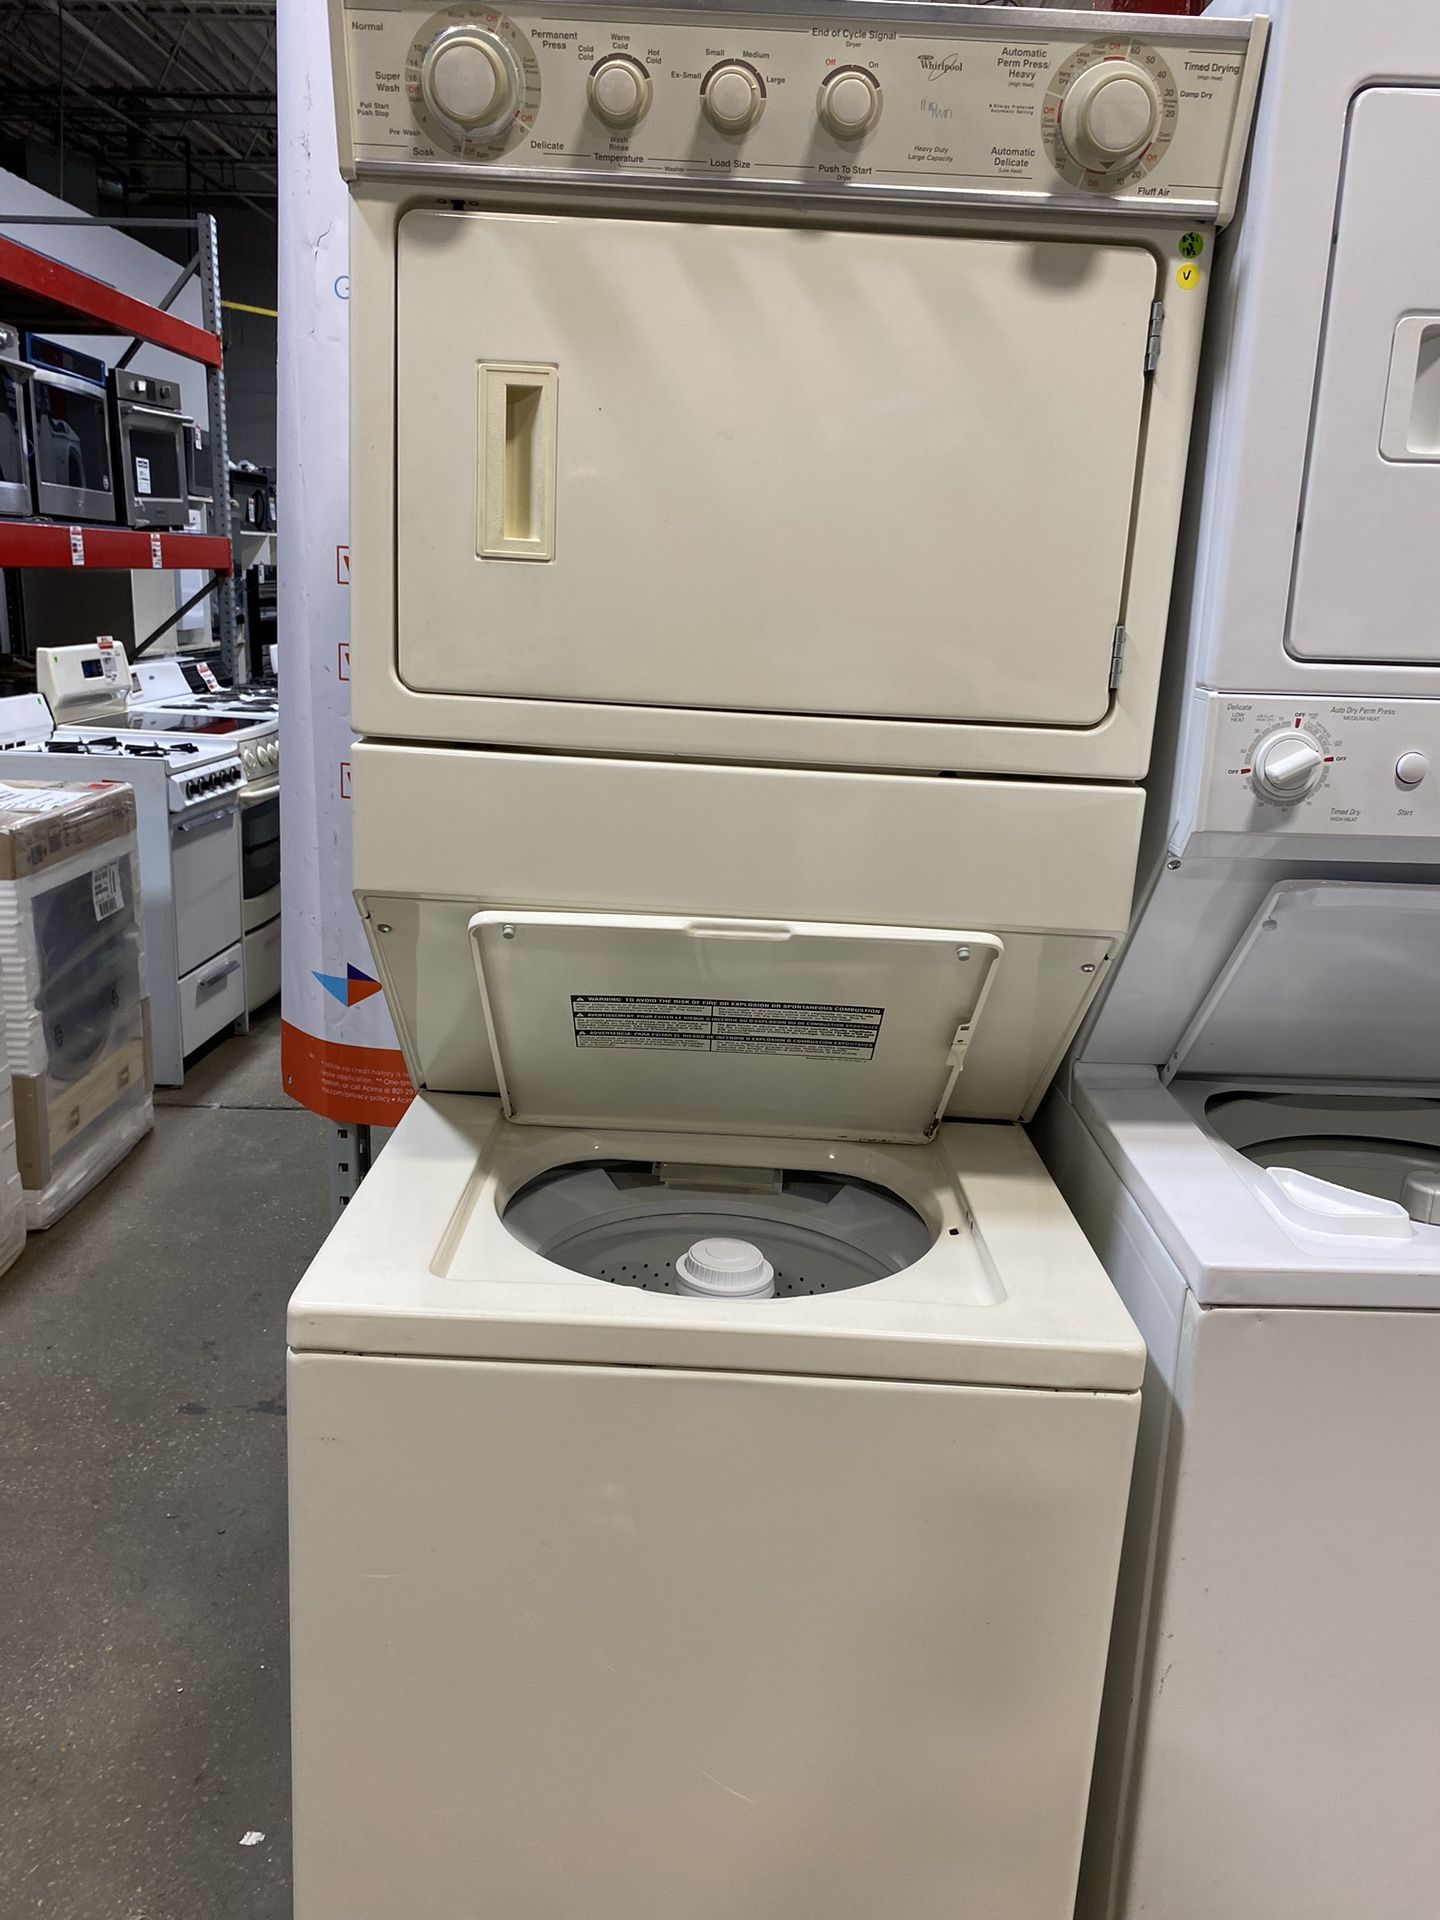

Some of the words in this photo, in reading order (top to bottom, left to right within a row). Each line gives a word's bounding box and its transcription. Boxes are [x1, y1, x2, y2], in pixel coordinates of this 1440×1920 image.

[351, 21, 384, 31] Normal
[531, 30, 578, 40] Permanent
[812, 28, 828, 38] End
[832, 30, 841, 38] of
[842, 30, 867, 40] Cycle
[869, 31, 897, 42] Signal
[542, 41, 567, 50] Press
[578, 45, 594, 53] Cold
[612, 42, 629, 50] Cold
[1109, 42, 1120, 50] Off
[1130, 46, 1140, 54] 60
[705, 48, 725, 56] Small
[742, 50, 770, 59] Medium
[1002, 47, 1048, 58] Automatic
[578, 53, 594, 61] Cold
[1146, 56, 1156, 64] 50
[825, 58, 836, 66] Off
[920, 60, 963, 73] Whirlpool
[997, 58, 1020, 68] Perm
[1184, 62, 1210, 72] Timed
[1212, 63, 1240, 75] Drying
[375, 71, 401, 82] Super
[671, 71, 702, 80] Ex-Small
[1008, 70, 1036, 80] Heavy
[1157, 70, 1168, 79] 40
[766, 76, 786, 84] Large
[376, 83, 400, 92] Wash
[1164, 89, 1174, 97] 30
[1180, 90, 1200, 98] Damp
[1200, 91, 1214, 100] Dry
[374, 109, 389, 118] Stop
[1165, 110, 1176, 118] 20
[530, 141, 565, 150] Delicate
[609, 144, 629, 152] Rinse
[914, 145, 932, 154] Heavy
[934, 146, 949, 154] Duty
[412, 147, 434, 156] Soak
[991, 147, 1036, 157] Automatic
[594, 153, 644, 163] Temperature
[908, 154, 926, 162] Large
[926, 154, 954, 164] Capacity
[1146, 153, 1158, 162] Off
[710, 159, 730, 168] Load
[733, 160, 751, 168] Size
[994, 158, 1030, 168] Delicate
[818, 164, 839, 174] Push
[841, 165, 850, 174] To
[852, 166, 872, 174] Start
[1138, 187, 1157, 196] Fluff
[1158, 188, 1170, 196] Air
[1227, 703, 1252, 711] Delicate
[1330, 706, 1345, 714] Auto
[1346, 707, 1358, 715] Dry
[1330, 808, 1348, 816] Timed
[1349, 809, 1360, 818] Dry
[1397, 809, 1414, 817] Start
[834, 1006, 881, 1014] COMBUSTION
[372, 1069, 394, 1077] history
